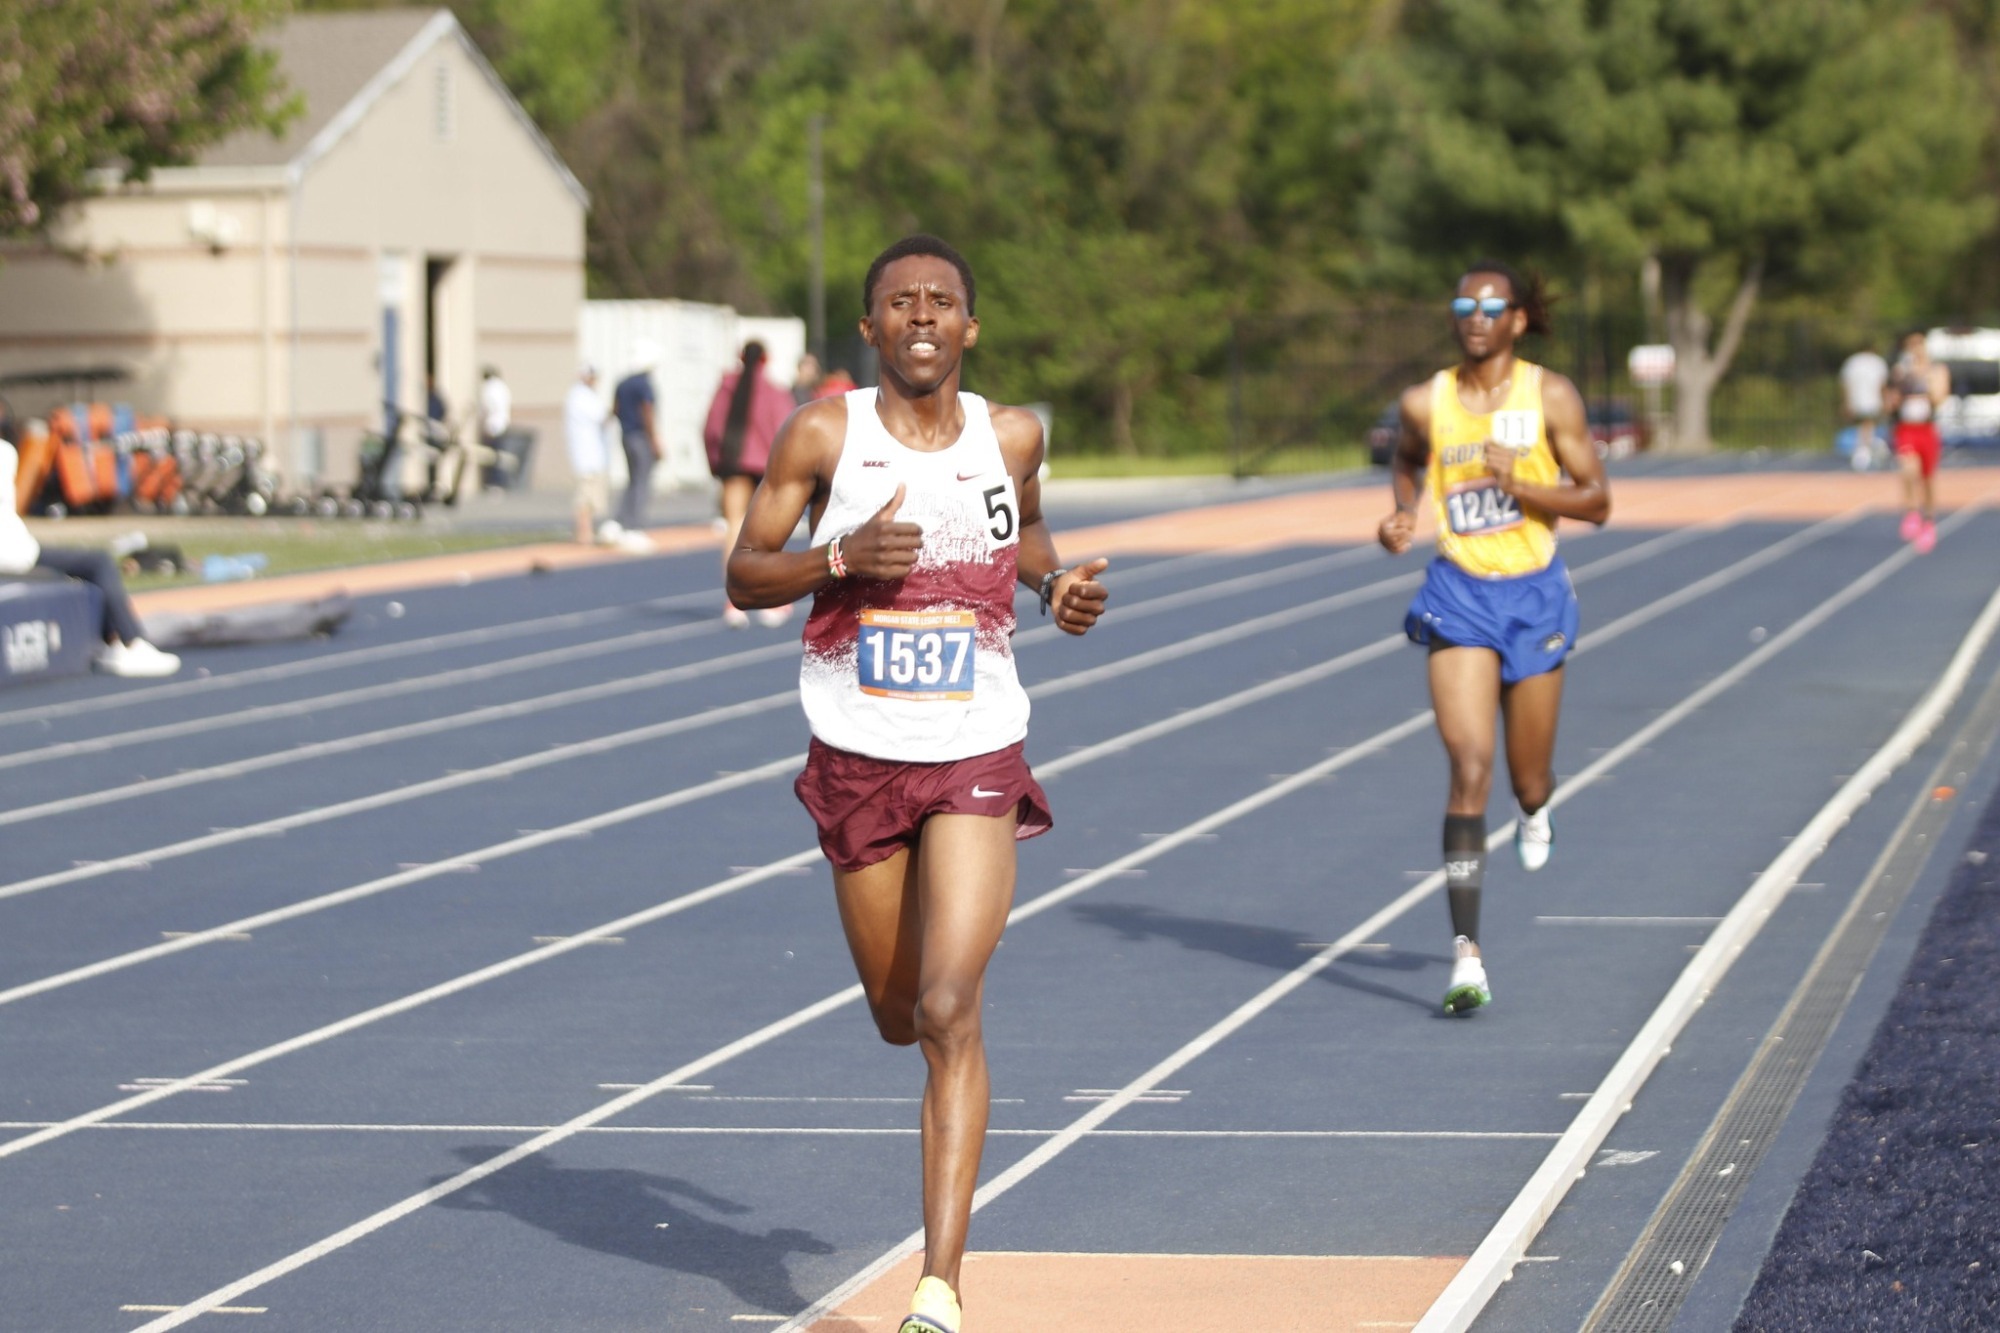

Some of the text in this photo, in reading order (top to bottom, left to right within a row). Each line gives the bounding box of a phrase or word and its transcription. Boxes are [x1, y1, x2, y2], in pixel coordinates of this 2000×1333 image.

[1500, 416, 1526, 439] 11
[983, 484, 1014, 541] 5
[873, 614, 961, 625] MORGAN STATE LEGACY MEET
[866, 631, 970, 684] 1537
